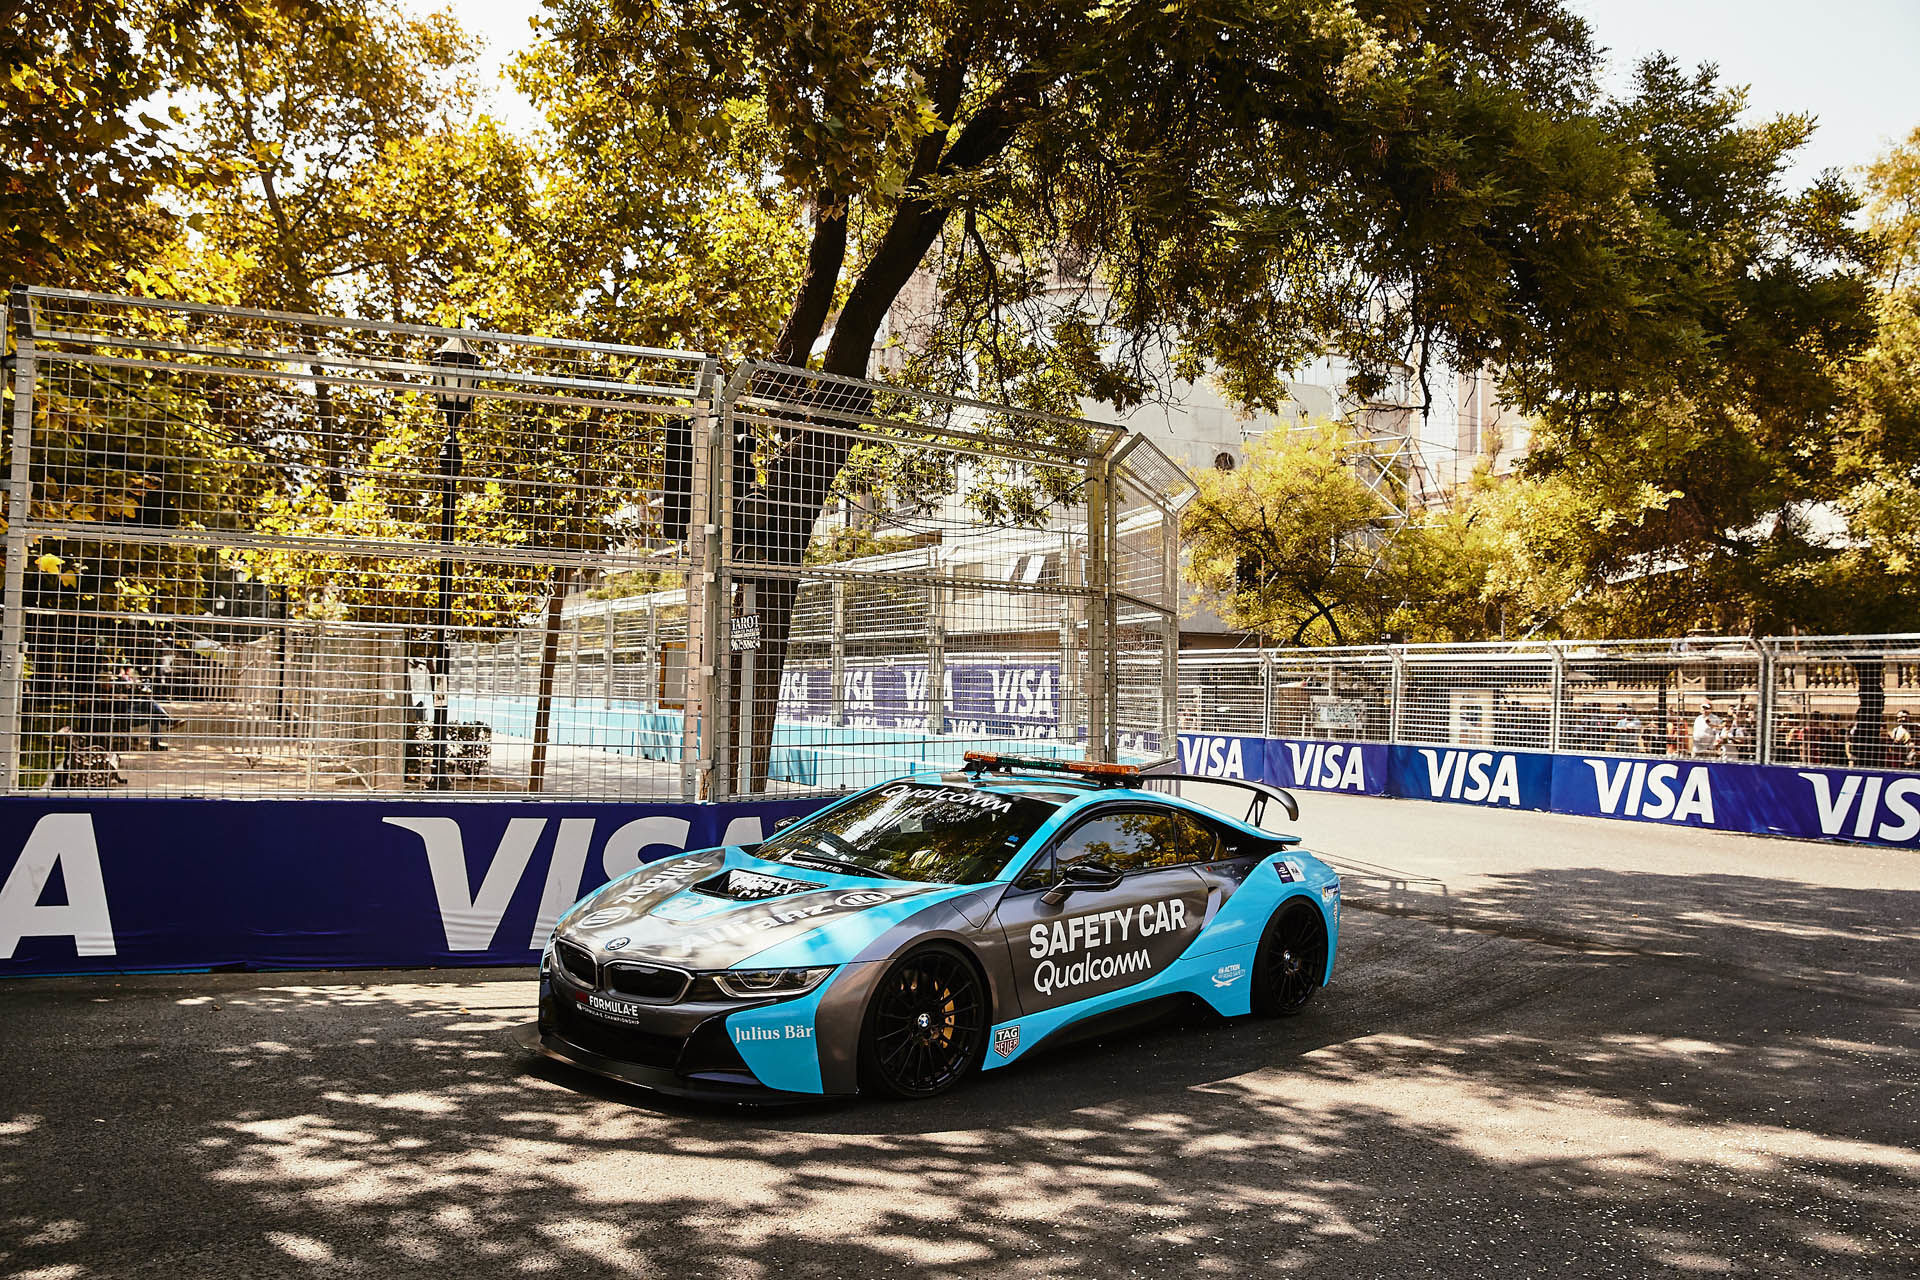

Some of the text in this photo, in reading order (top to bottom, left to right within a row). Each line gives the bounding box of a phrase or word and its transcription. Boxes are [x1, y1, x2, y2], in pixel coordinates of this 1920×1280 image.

[731, 615, 760, 630] TAROT
[902, 669, 954, 712] VIA
[987, 669, 1054, 718] VISA
[1177, 737, 1244, 779] VISA
[1285, 743, 1364, 790] VISA
[1418, 750, 1520, 805] VISA
[881, 785, 1012, 813] Qualcomm
[1584, 760, 1714, 823] VISA
[612, 859, 712, 906] Allianz
[679, 904, 834, 953] Allianz
[1030, 899, 1187, 959] SAFETY CAR
[1034, 949, 1151, 996] Qualcomm
[735, 1025, 814, 1043] Julius Bär
[996, 1039, 1018, 1055] HEUER
[997, 1028, 1018, 1041] TAG
